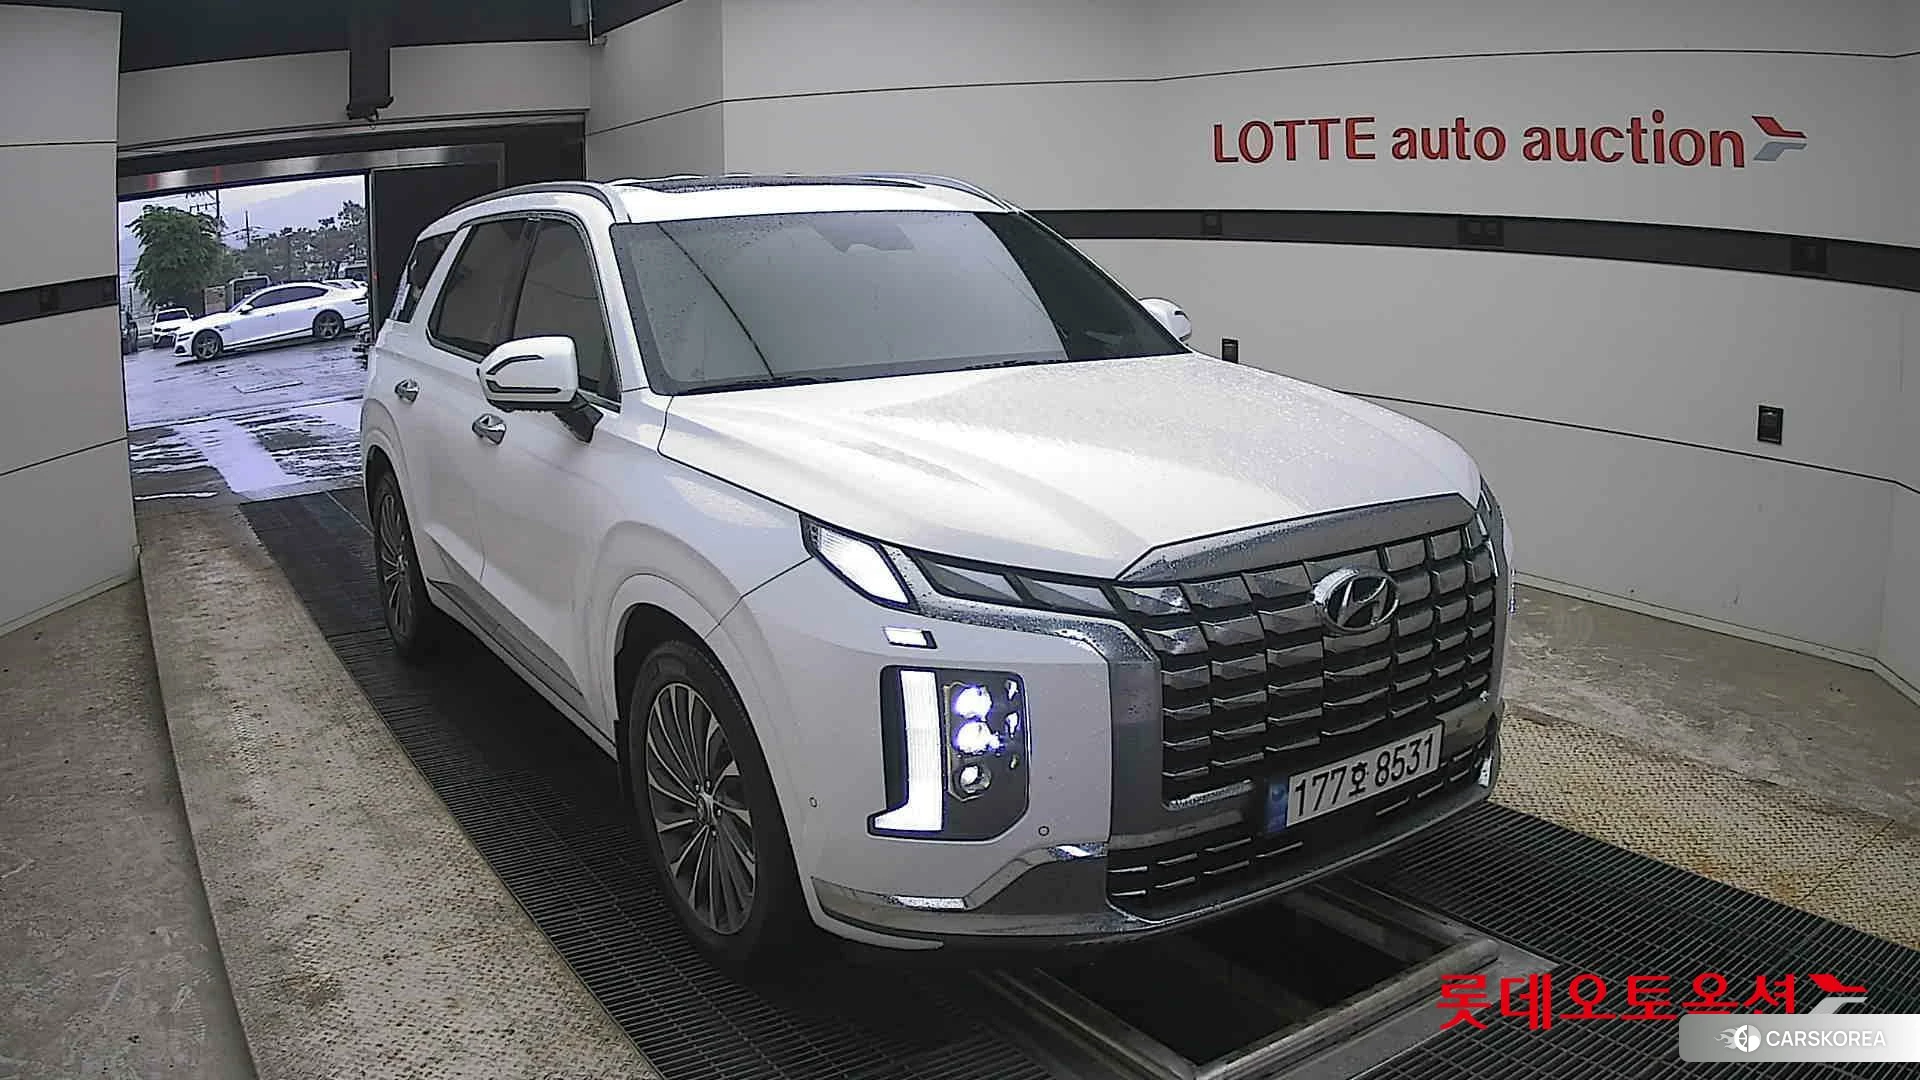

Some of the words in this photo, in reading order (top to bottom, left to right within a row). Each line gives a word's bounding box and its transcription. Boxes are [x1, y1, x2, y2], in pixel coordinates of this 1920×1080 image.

[1213, 116, 1376, 163] LOTTE
[1391, 116, 1506, 161] auto
[1522, 109, 1745, 168] auction
[1374, 733, 1434, 787] 8531
